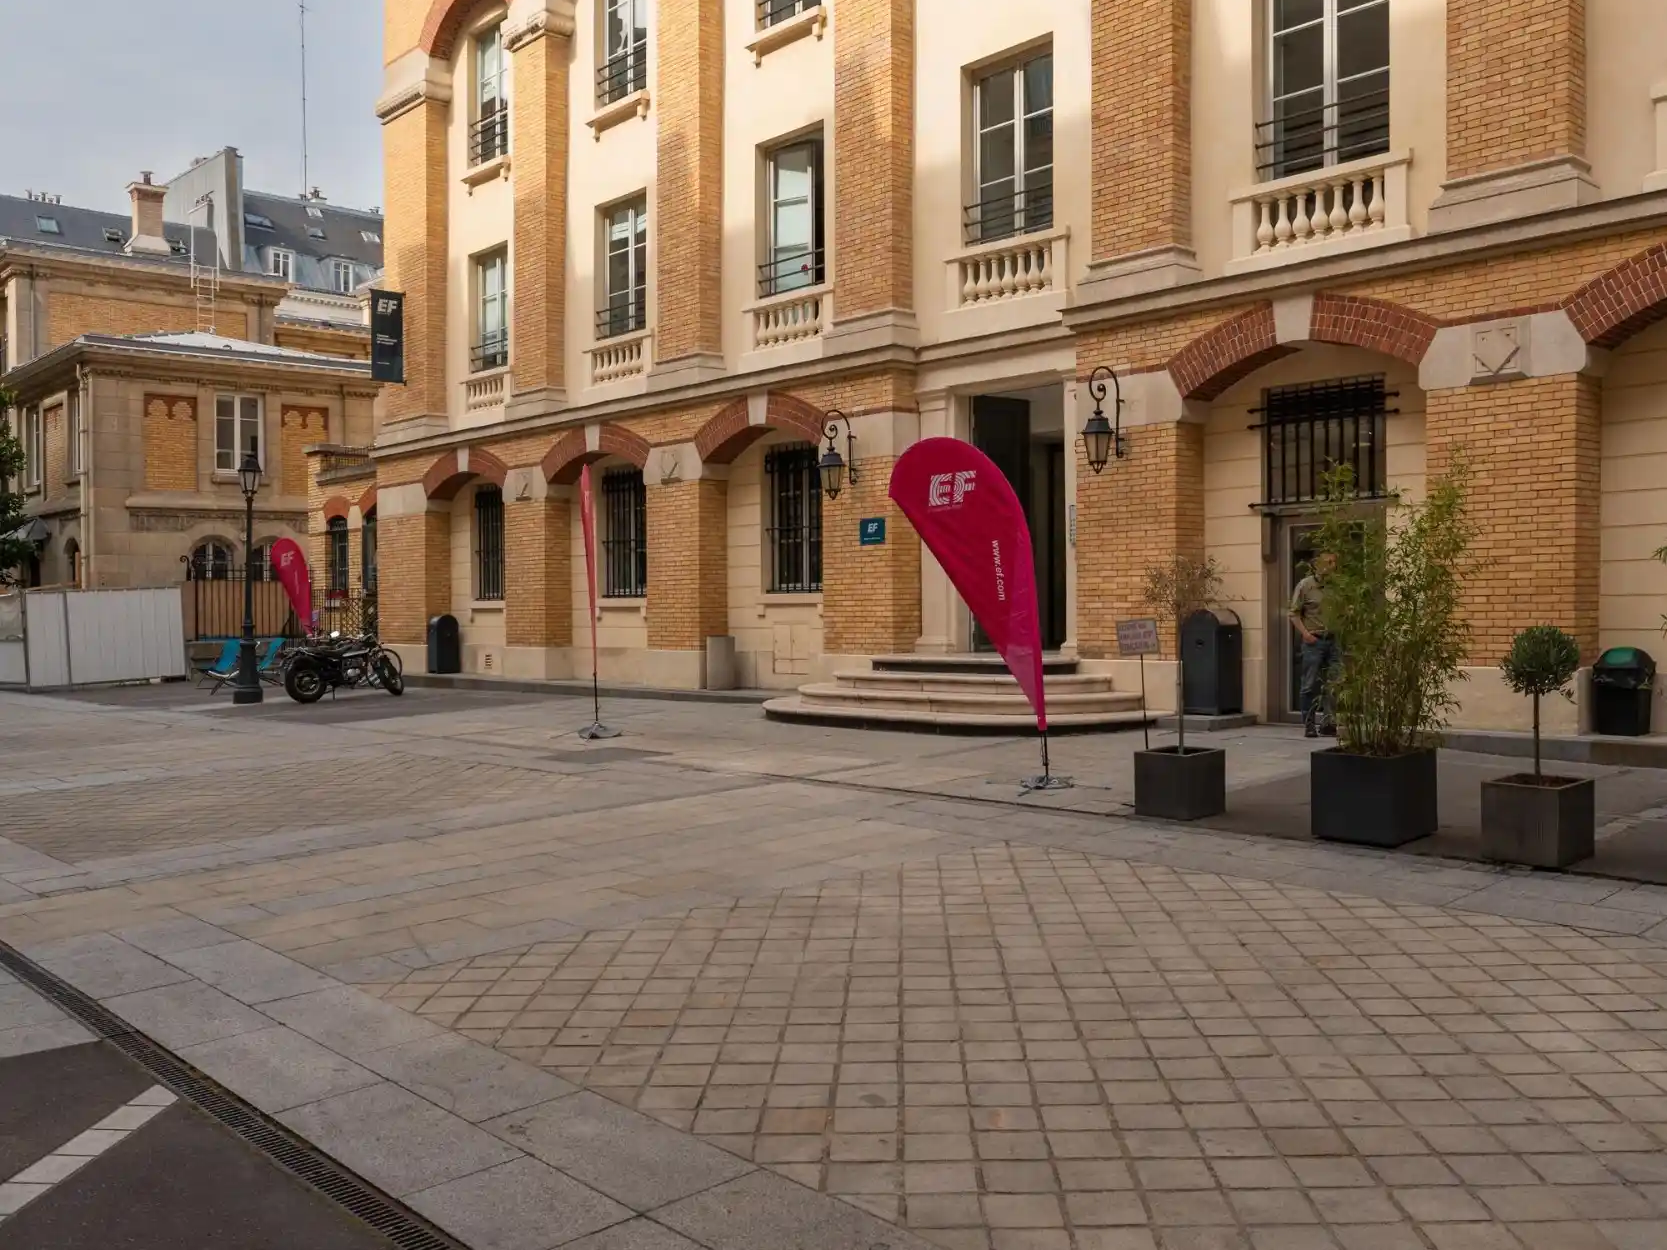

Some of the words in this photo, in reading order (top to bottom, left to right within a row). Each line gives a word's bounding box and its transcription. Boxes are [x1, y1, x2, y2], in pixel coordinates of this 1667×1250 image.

[377, 298, 398, 314] EF
[929, 470, 977, 507] EF
[867, 522, 878, 533] EF
[281, 551, 296, 567] EF
[992, 539, 1006, 601] www.ef.com
